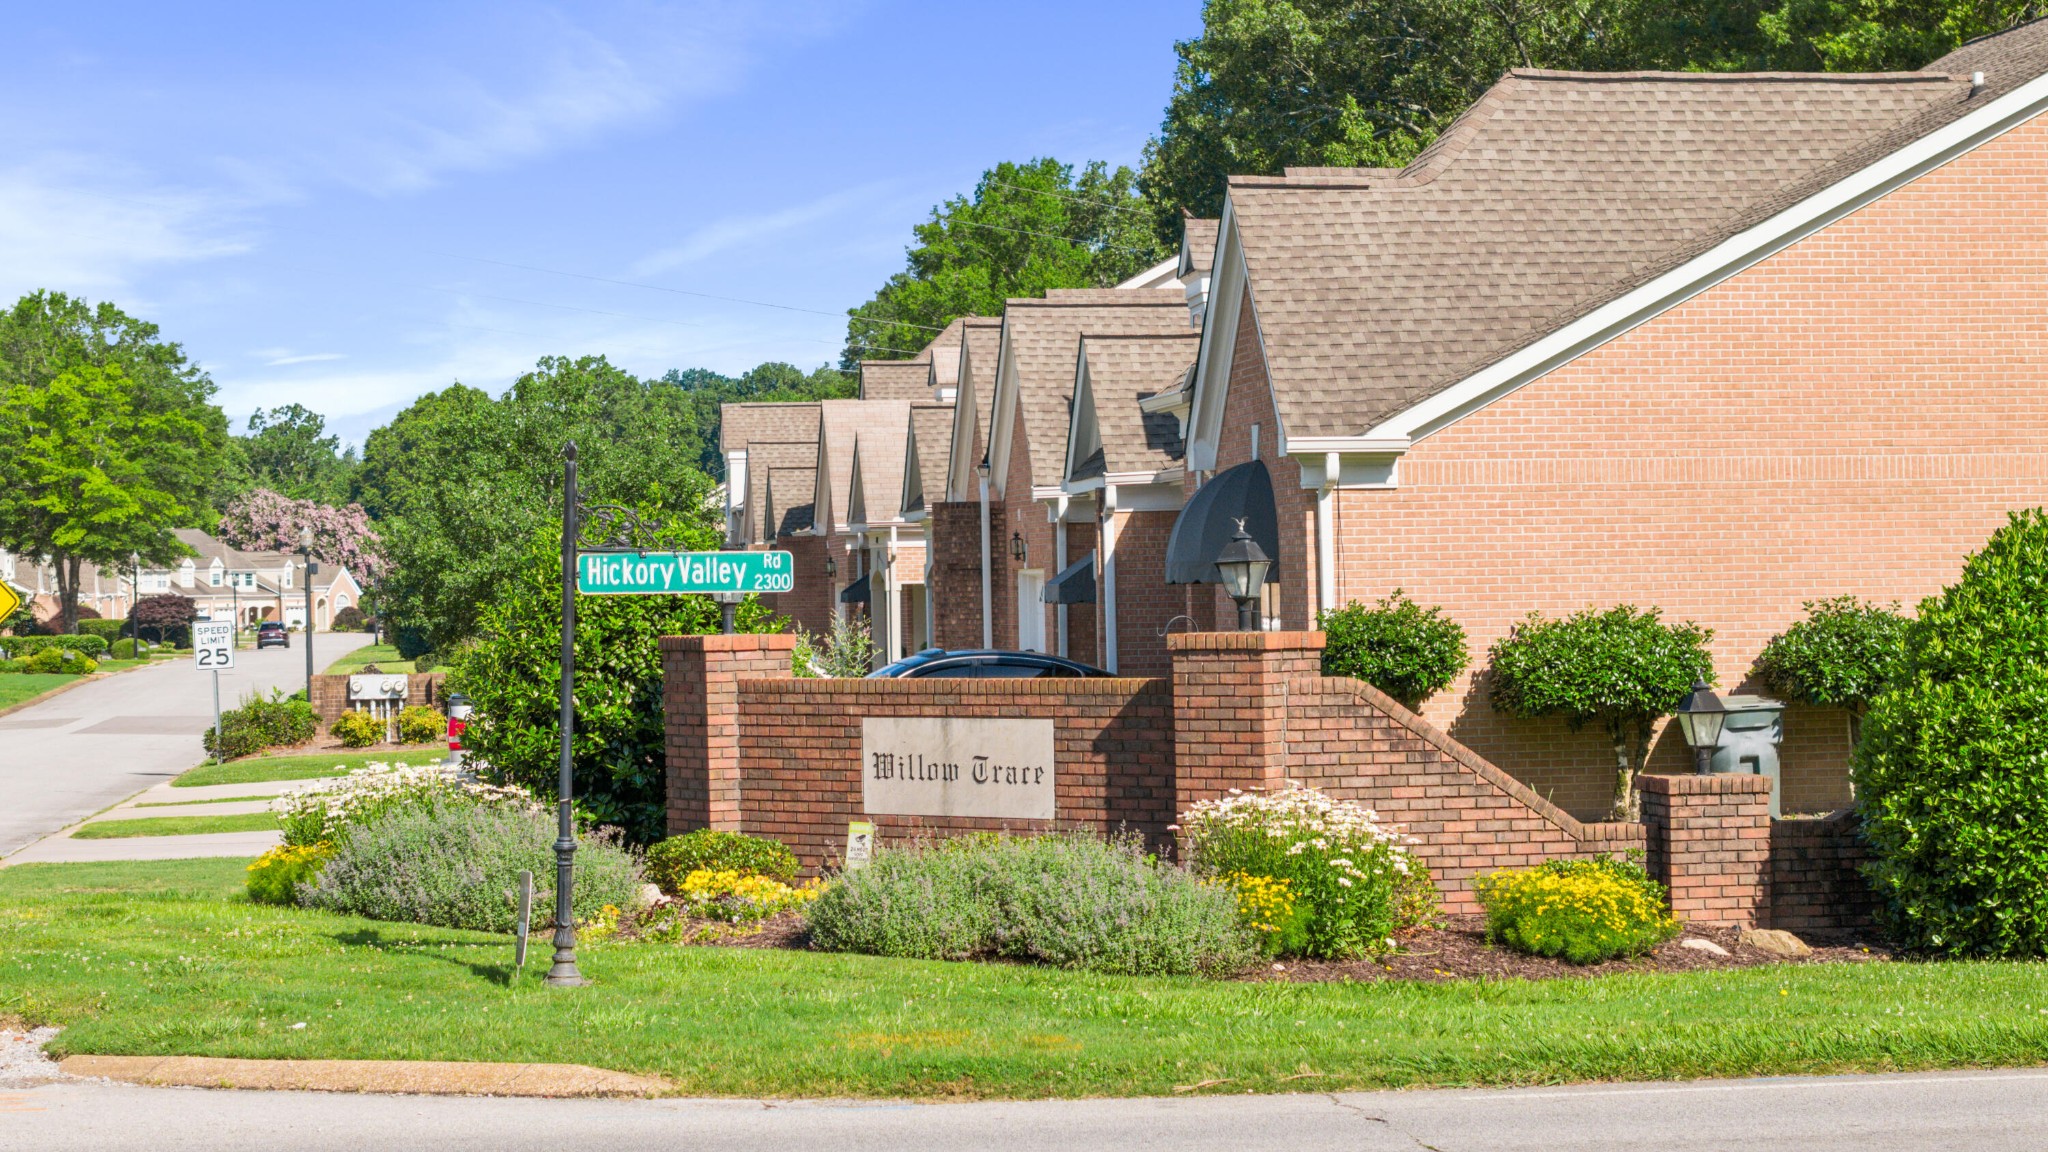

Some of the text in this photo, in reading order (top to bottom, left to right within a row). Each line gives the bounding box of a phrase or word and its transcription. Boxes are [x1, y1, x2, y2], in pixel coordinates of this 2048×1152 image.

[587, 553, 781, 589] Hickory Valley Rd
[754, 573, 790, 590] 2300
[197, 626, 229, 635] SPEED
[200, 636, 226, 645] LIMIT
[198, 648, 230, 665] 25
[872, 751, 1045, 785] Willow Trace
